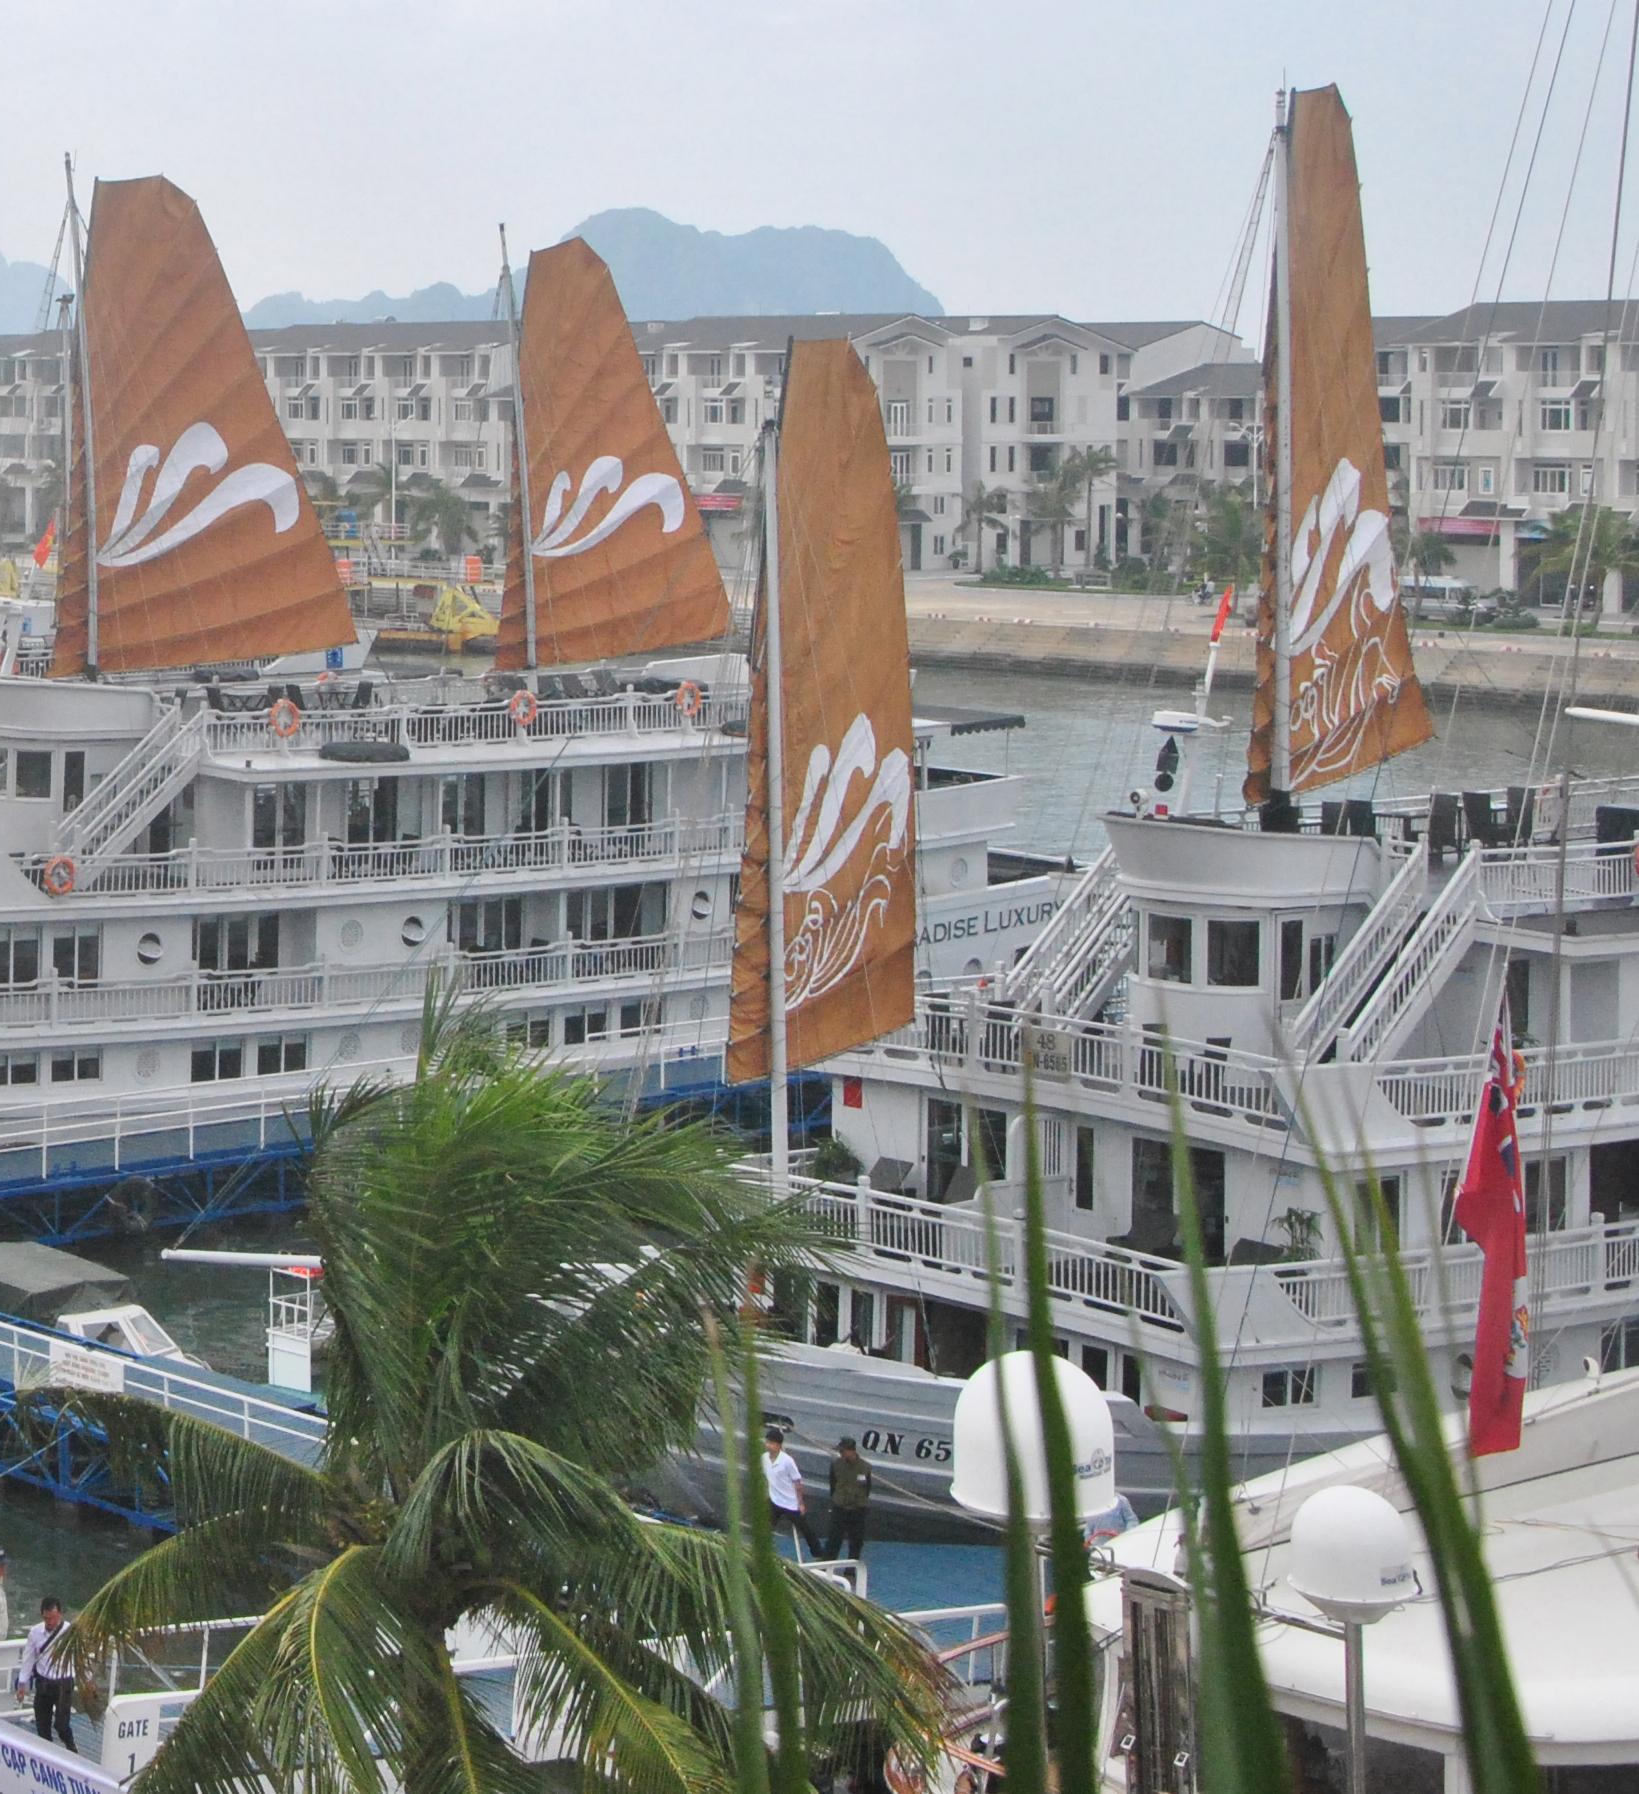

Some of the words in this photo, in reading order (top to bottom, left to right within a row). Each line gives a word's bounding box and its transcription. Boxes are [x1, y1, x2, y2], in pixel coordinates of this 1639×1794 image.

[915, 1438, 953, 1462] 65
[118, 1719, 149, 1739] GATE
[128, 1752, 135, 1774] 1
